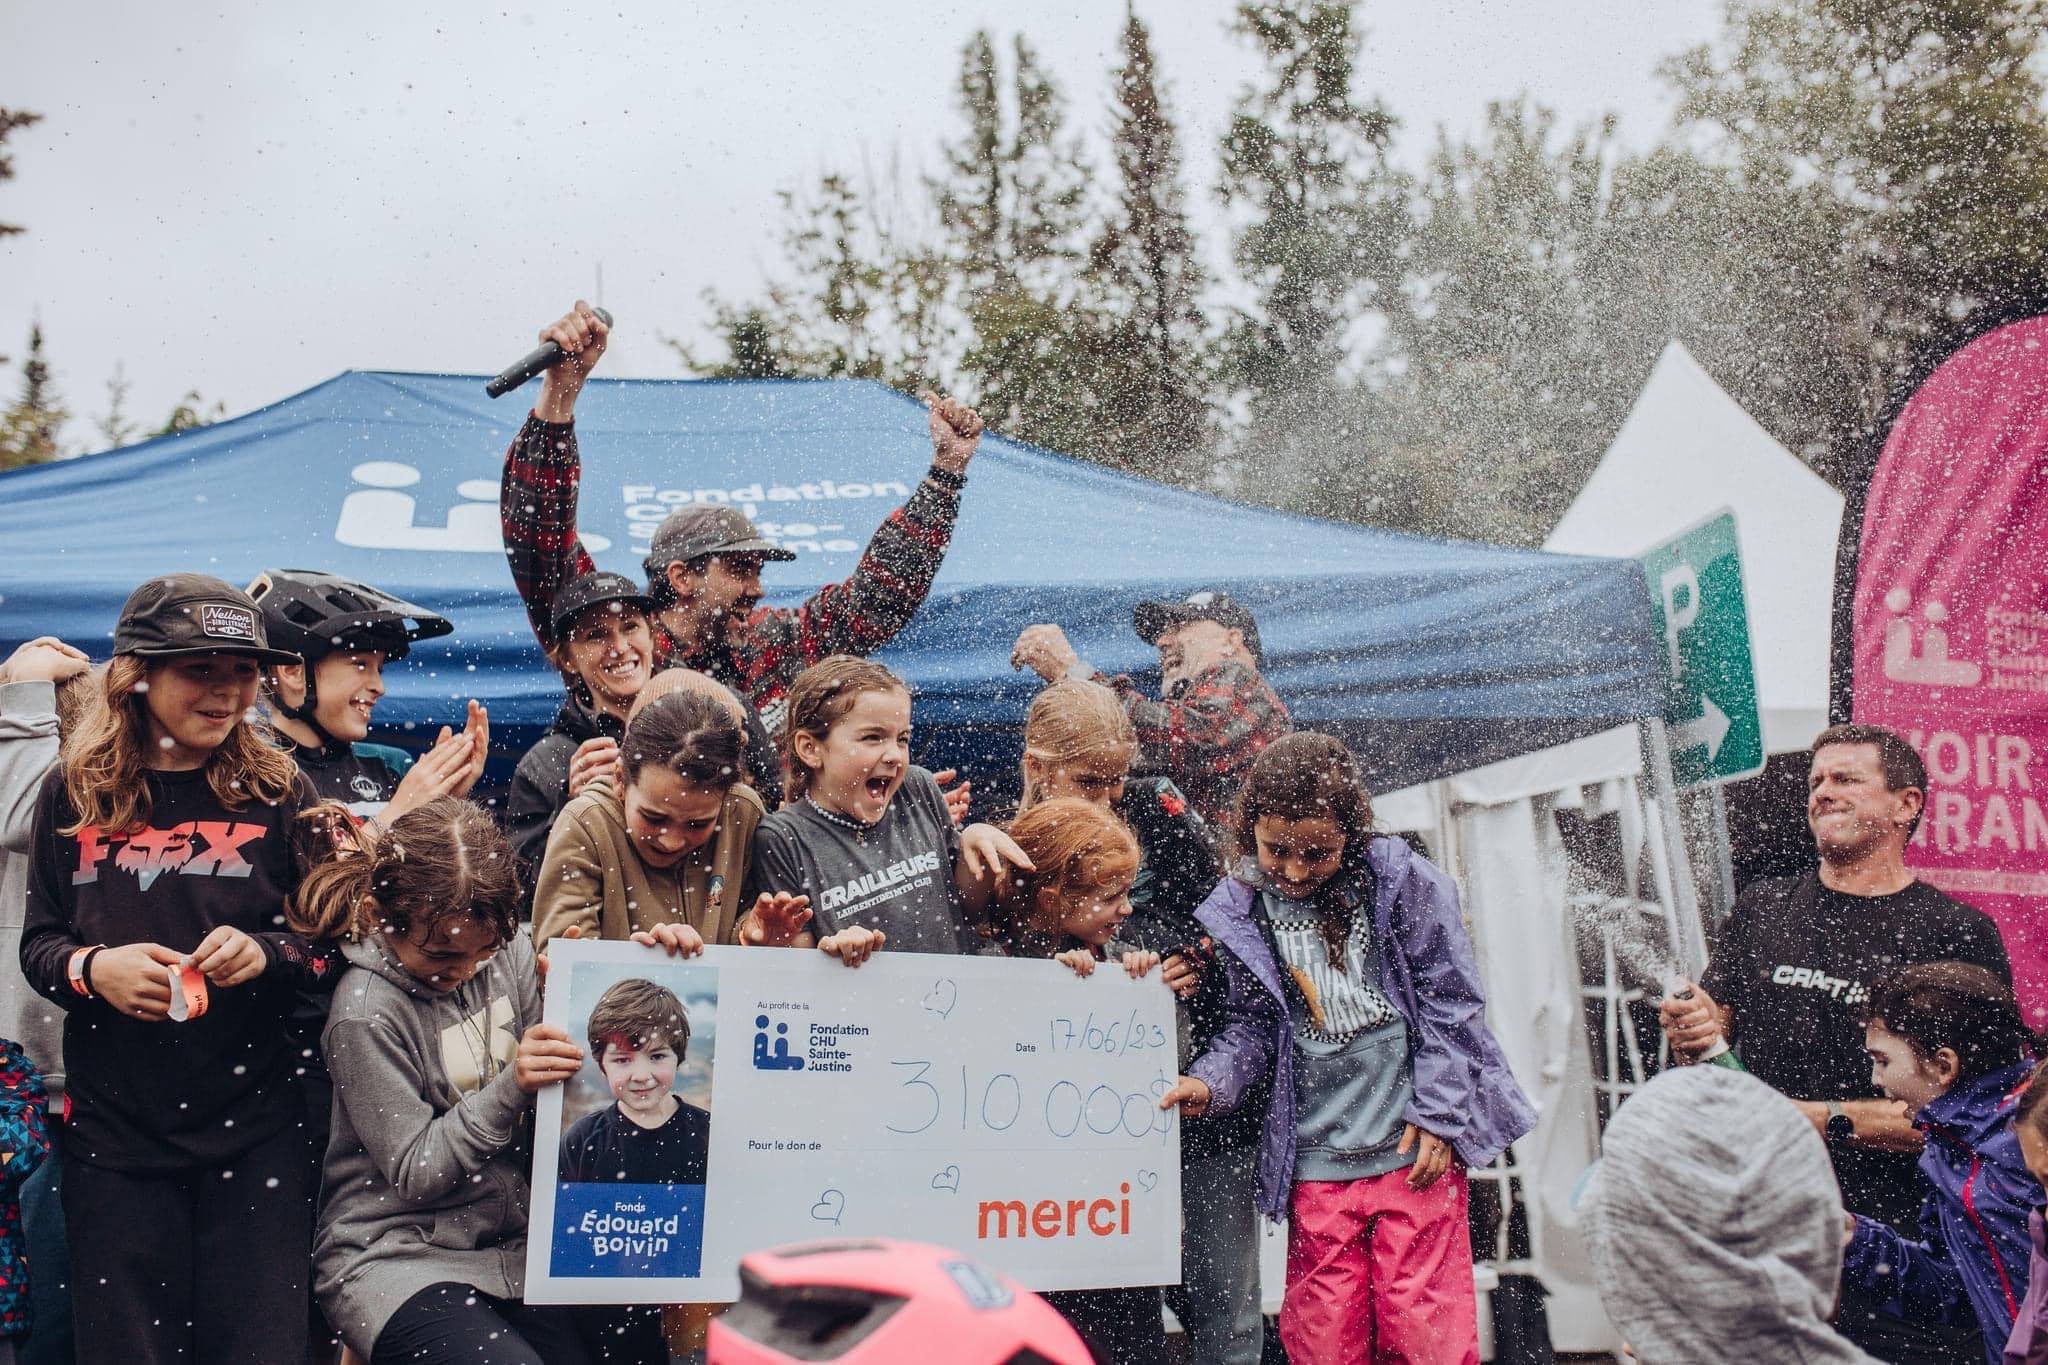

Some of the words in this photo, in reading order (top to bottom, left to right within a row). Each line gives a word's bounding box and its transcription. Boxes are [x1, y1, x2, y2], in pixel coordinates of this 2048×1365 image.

[621, 479, 910, 504] Fondation
[205, 607, 251, 623] Neilson
[1662, 565, 1700, 681] P
[72, 820, 268, 892] FOX
[1773, 964, 1850, 999] CRAFT
[757, 1001, 768, 1009] Au
[769, 1001, 790, 1011] profit
[791, 1002, 801, 1010] de
[802, 1002, 809, 1011] la
[810, 1023, 869, 1035] Fondation
[1050, 1009, 1166, 1056] 17/06/23
[809, 1036, 837, 1047] CHU
[1015, 1043, 1036, 1053] Date
[808, 1048, 852, 1060] Sainte-
[807, 1060, 852, 1072] Justine
[886, 1061, 1021, 1134] 310
[748, 1140, 773, 1150] Pour
[774, 1139, 784, 1150] le
[786, 1139, 806, 1150] don
[808, 1140, 822, 1150] de
[614, 1202, 646, 1213] Fonds
[977, 1182, 1130, 1239] merci
[580, 1209, 679, 1235] Édouard
[593, 1236, 669, 1257] Boivin
